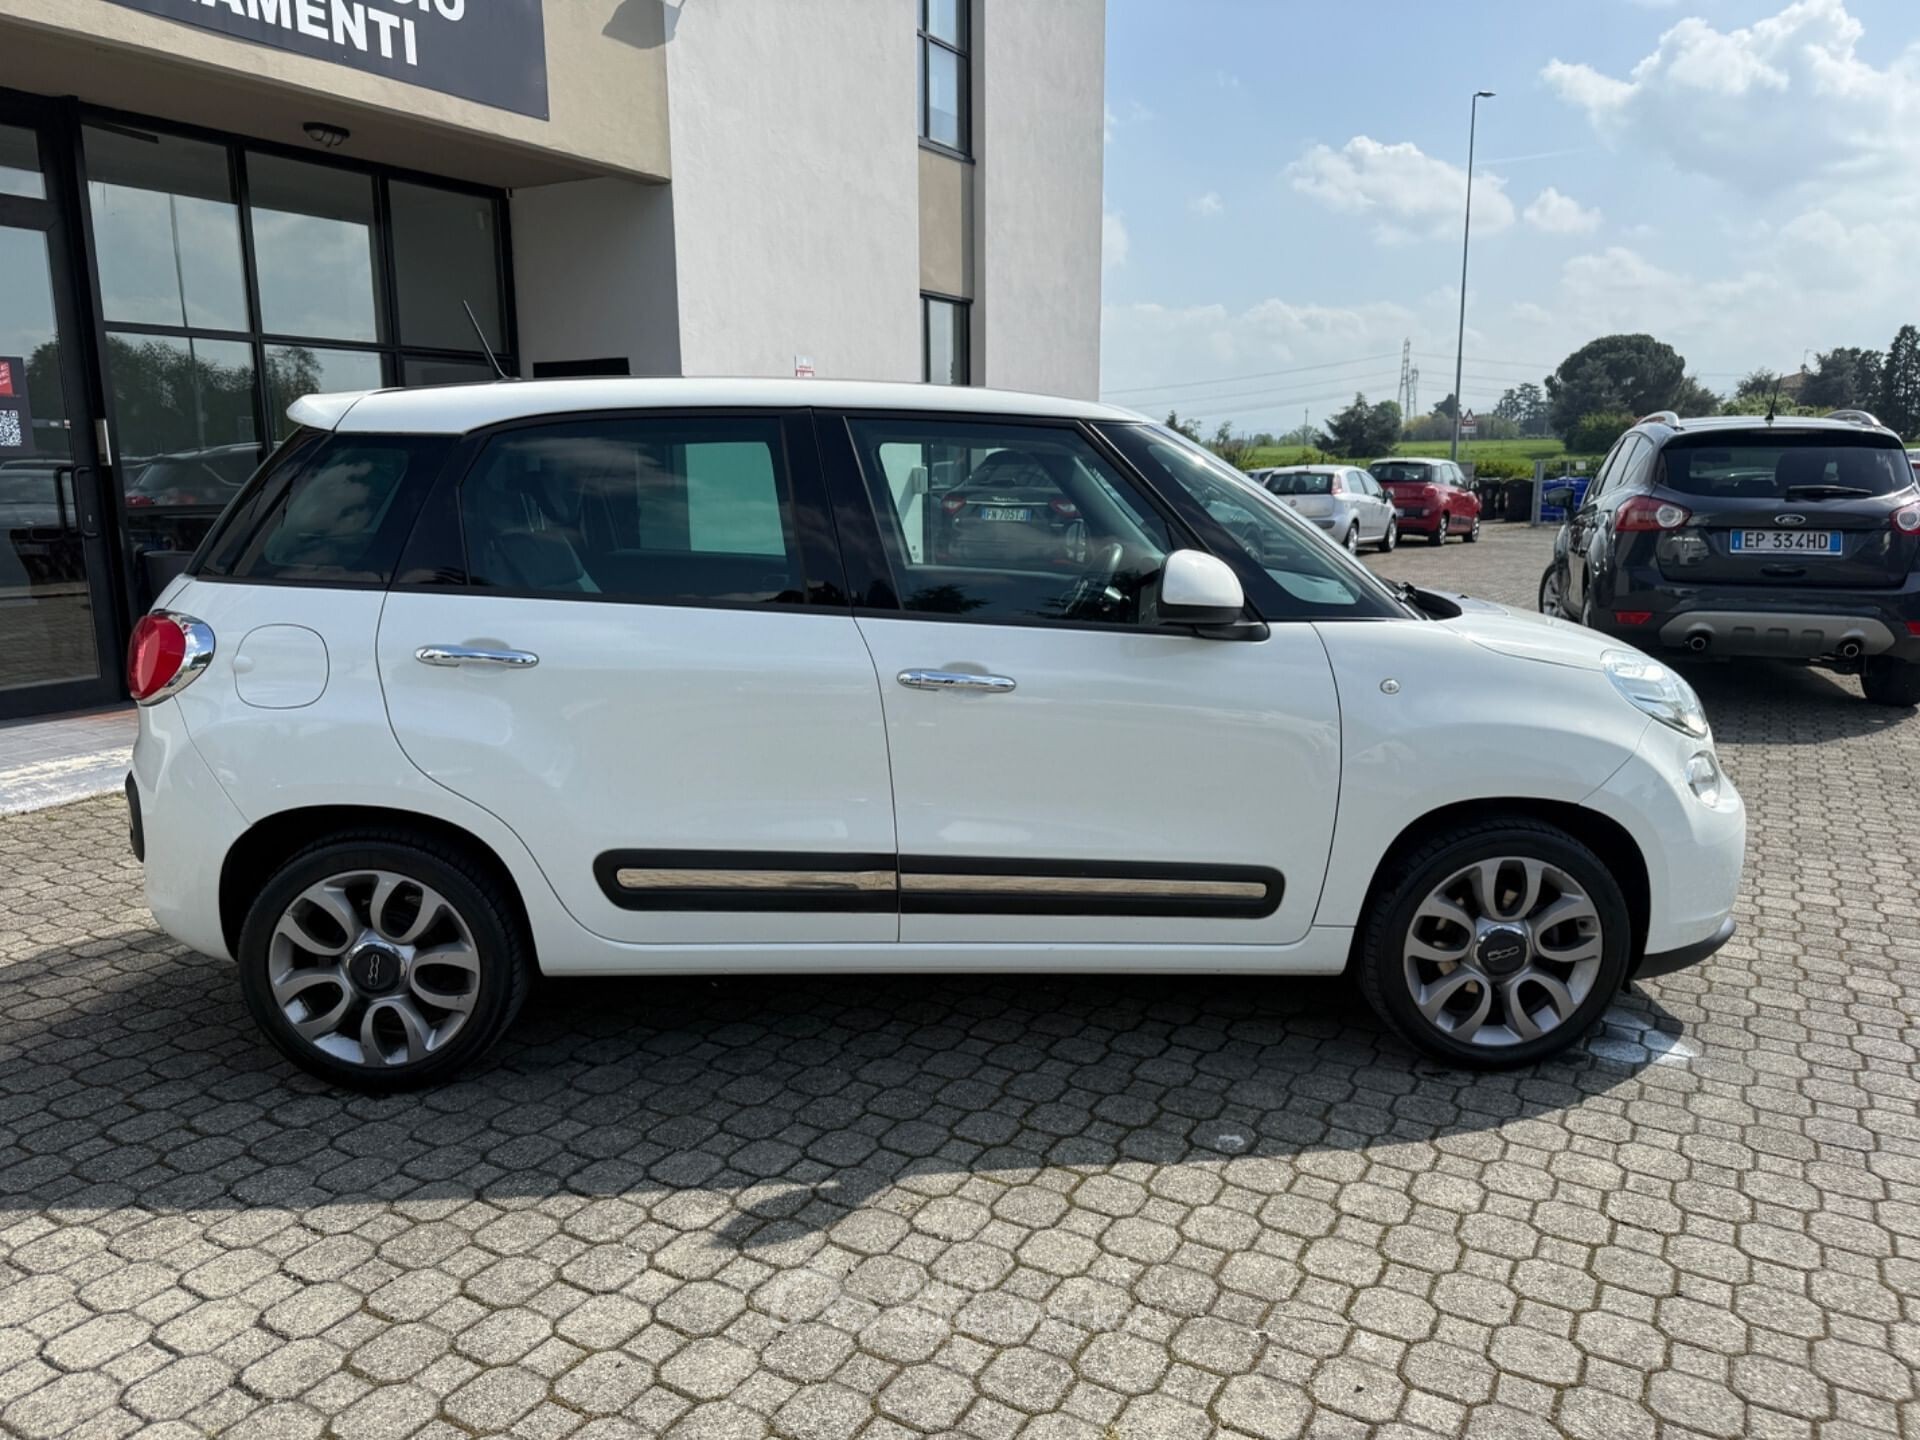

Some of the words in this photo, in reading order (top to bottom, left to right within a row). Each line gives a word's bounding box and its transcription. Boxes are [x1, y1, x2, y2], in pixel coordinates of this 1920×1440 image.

[192, 0, 417, 66] MENTI
[1744, 532, 1765, 548] EP
[1773, 533, 1828, 549] 334HD
